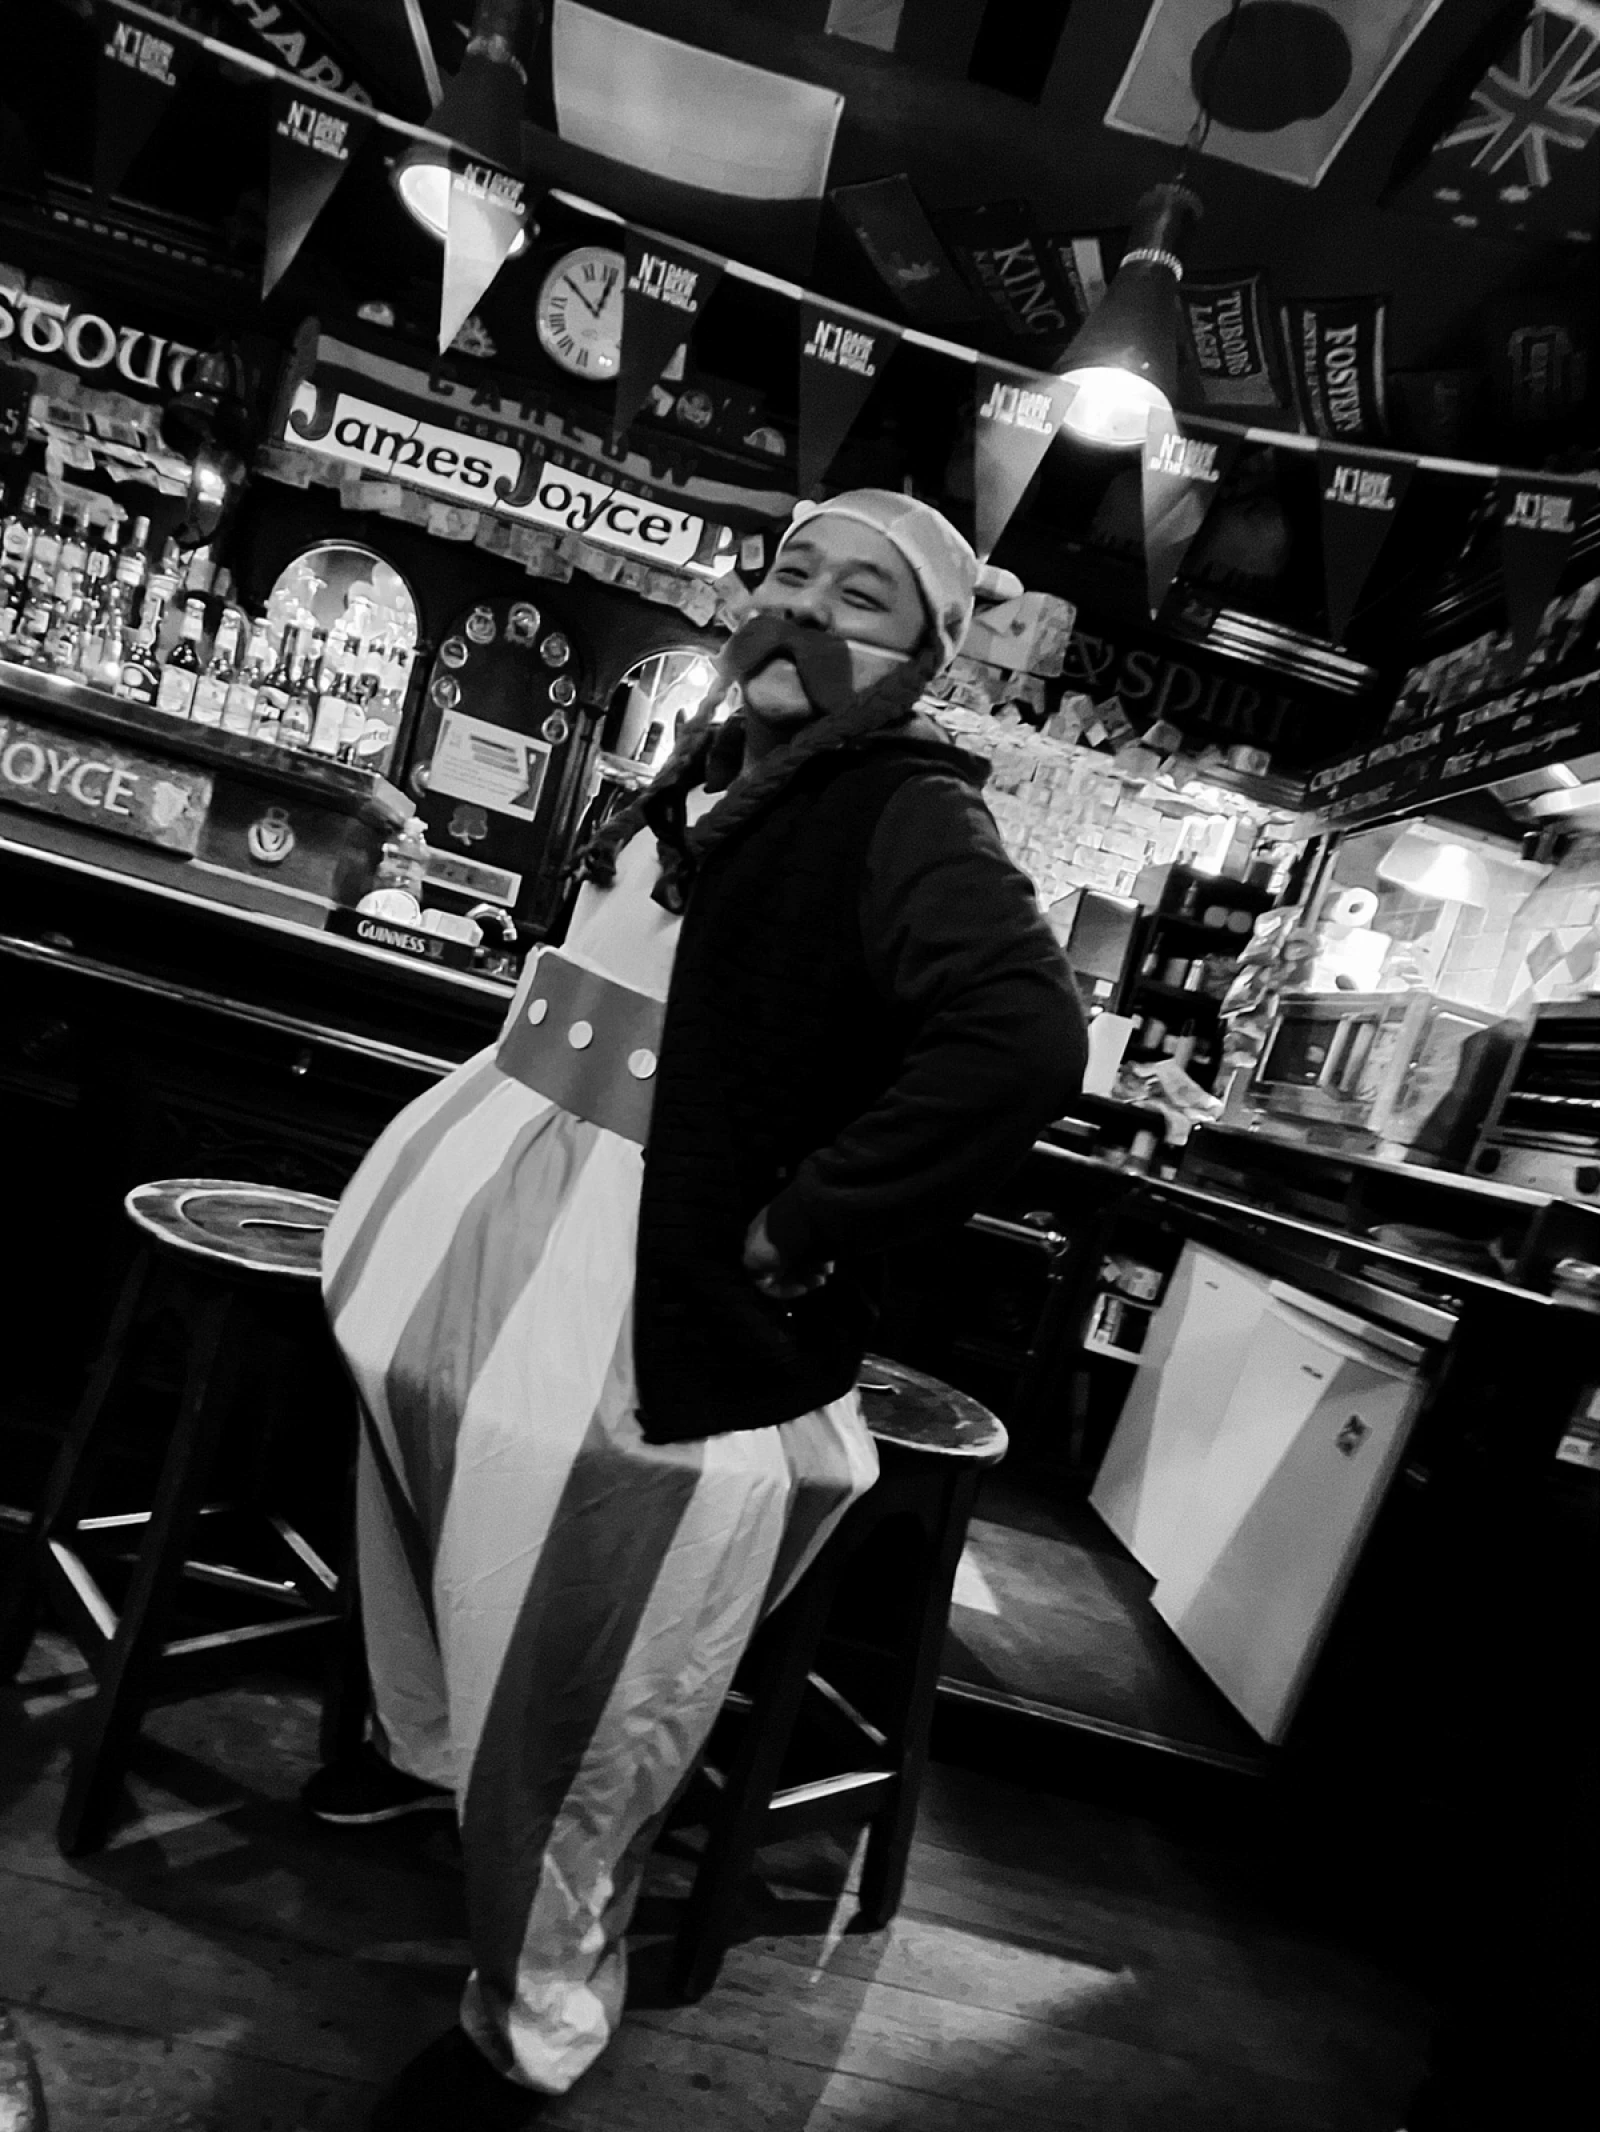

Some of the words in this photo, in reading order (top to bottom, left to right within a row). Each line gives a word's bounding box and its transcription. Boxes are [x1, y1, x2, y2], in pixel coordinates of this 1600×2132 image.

[289, 378, 494, 489] James
[0, 724, 139, 815] OYCE
[357, 919, 426, 954] GUINNESS
